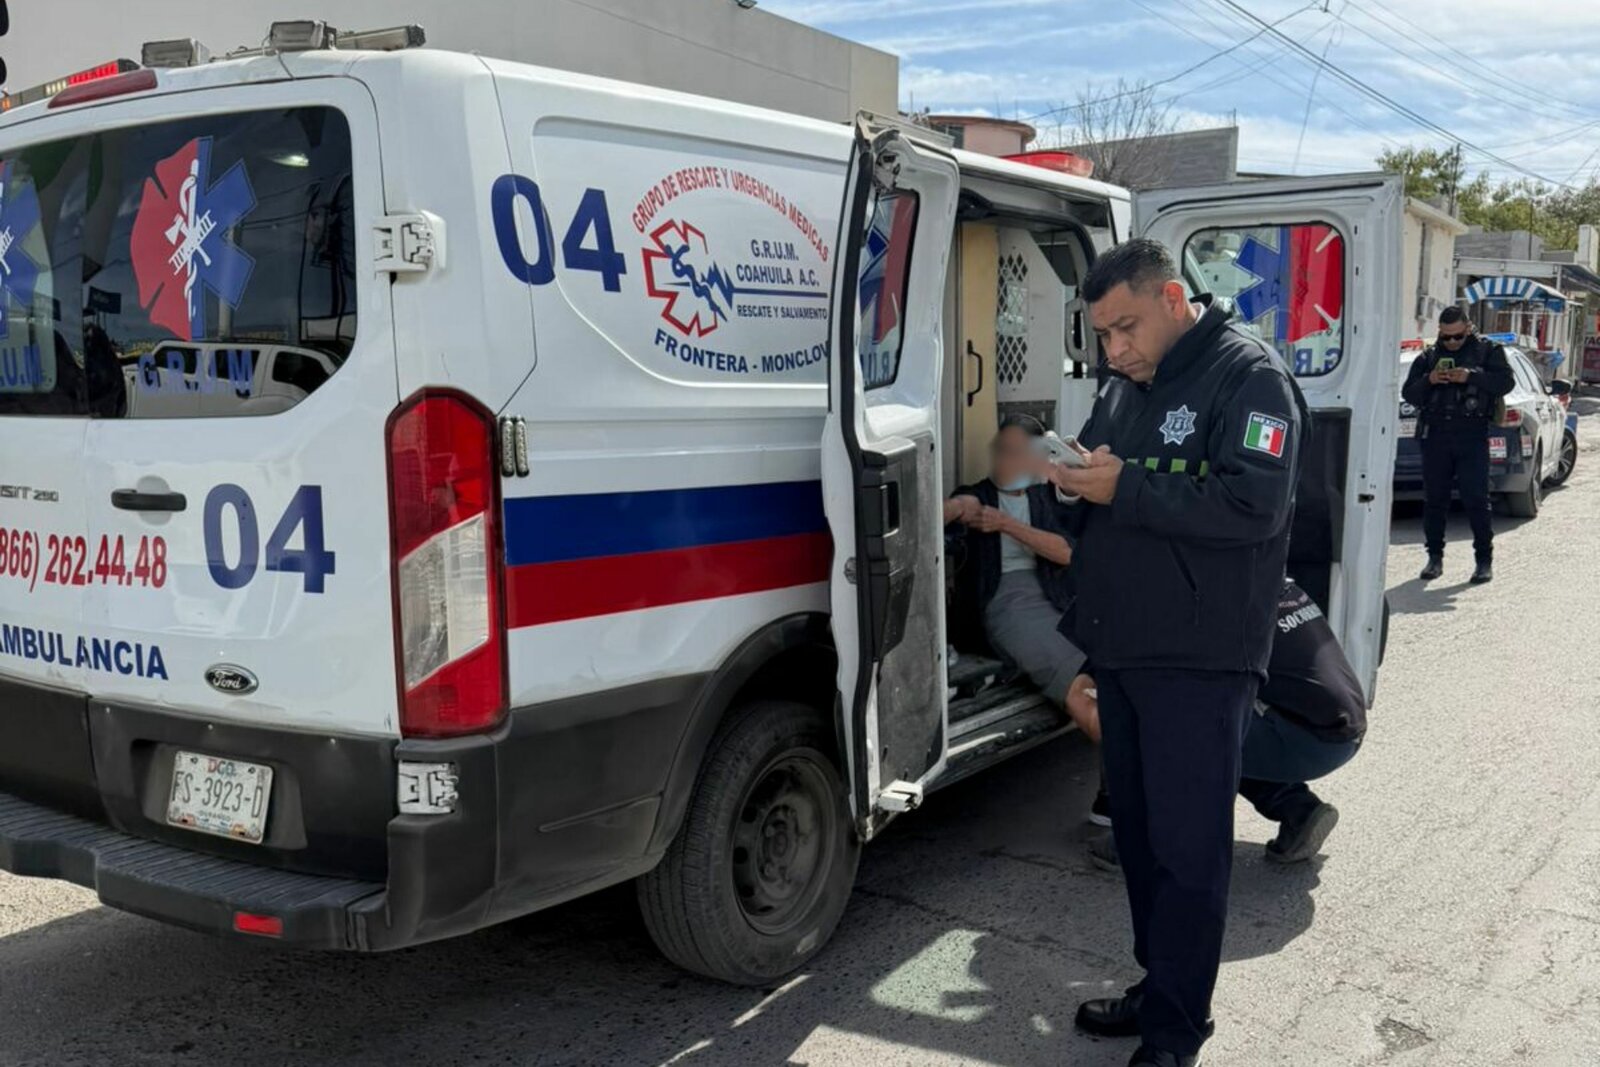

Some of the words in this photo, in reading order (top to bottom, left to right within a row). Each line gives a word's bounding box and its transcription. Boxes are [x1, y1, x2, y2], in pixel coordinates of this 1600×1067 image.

[490, 173, 627, 293] 04
[632, 185, 664, 234] GRUPO
[661, 175, 679, 201] DE
[676, 166, 721, 194] RESCATE
[720, 167, 729, 189] Y
[730, 169, 786, 215] URGENCIAS
[788, 202, 829, 262] MEDICAS
[736, 264, 795, 285] COAHUILA
[800, 269, 820, 286] A.C.
[751, 239, 800, 261] G.R.U.M.
[736, 304, 773, 318] RESCATE
[773, 305, 780, 318] Y
[780, 306, 828, 320] SALVAMENTO
[654, 328, 749, 374] FRONTERA
[45, 533, 168, 588] 262.44.48
[203, 483, 336, 594] 04
[0, 623, 169, 681] MBULANCIA
[172, 770, 263, 818] FS-3923-D
